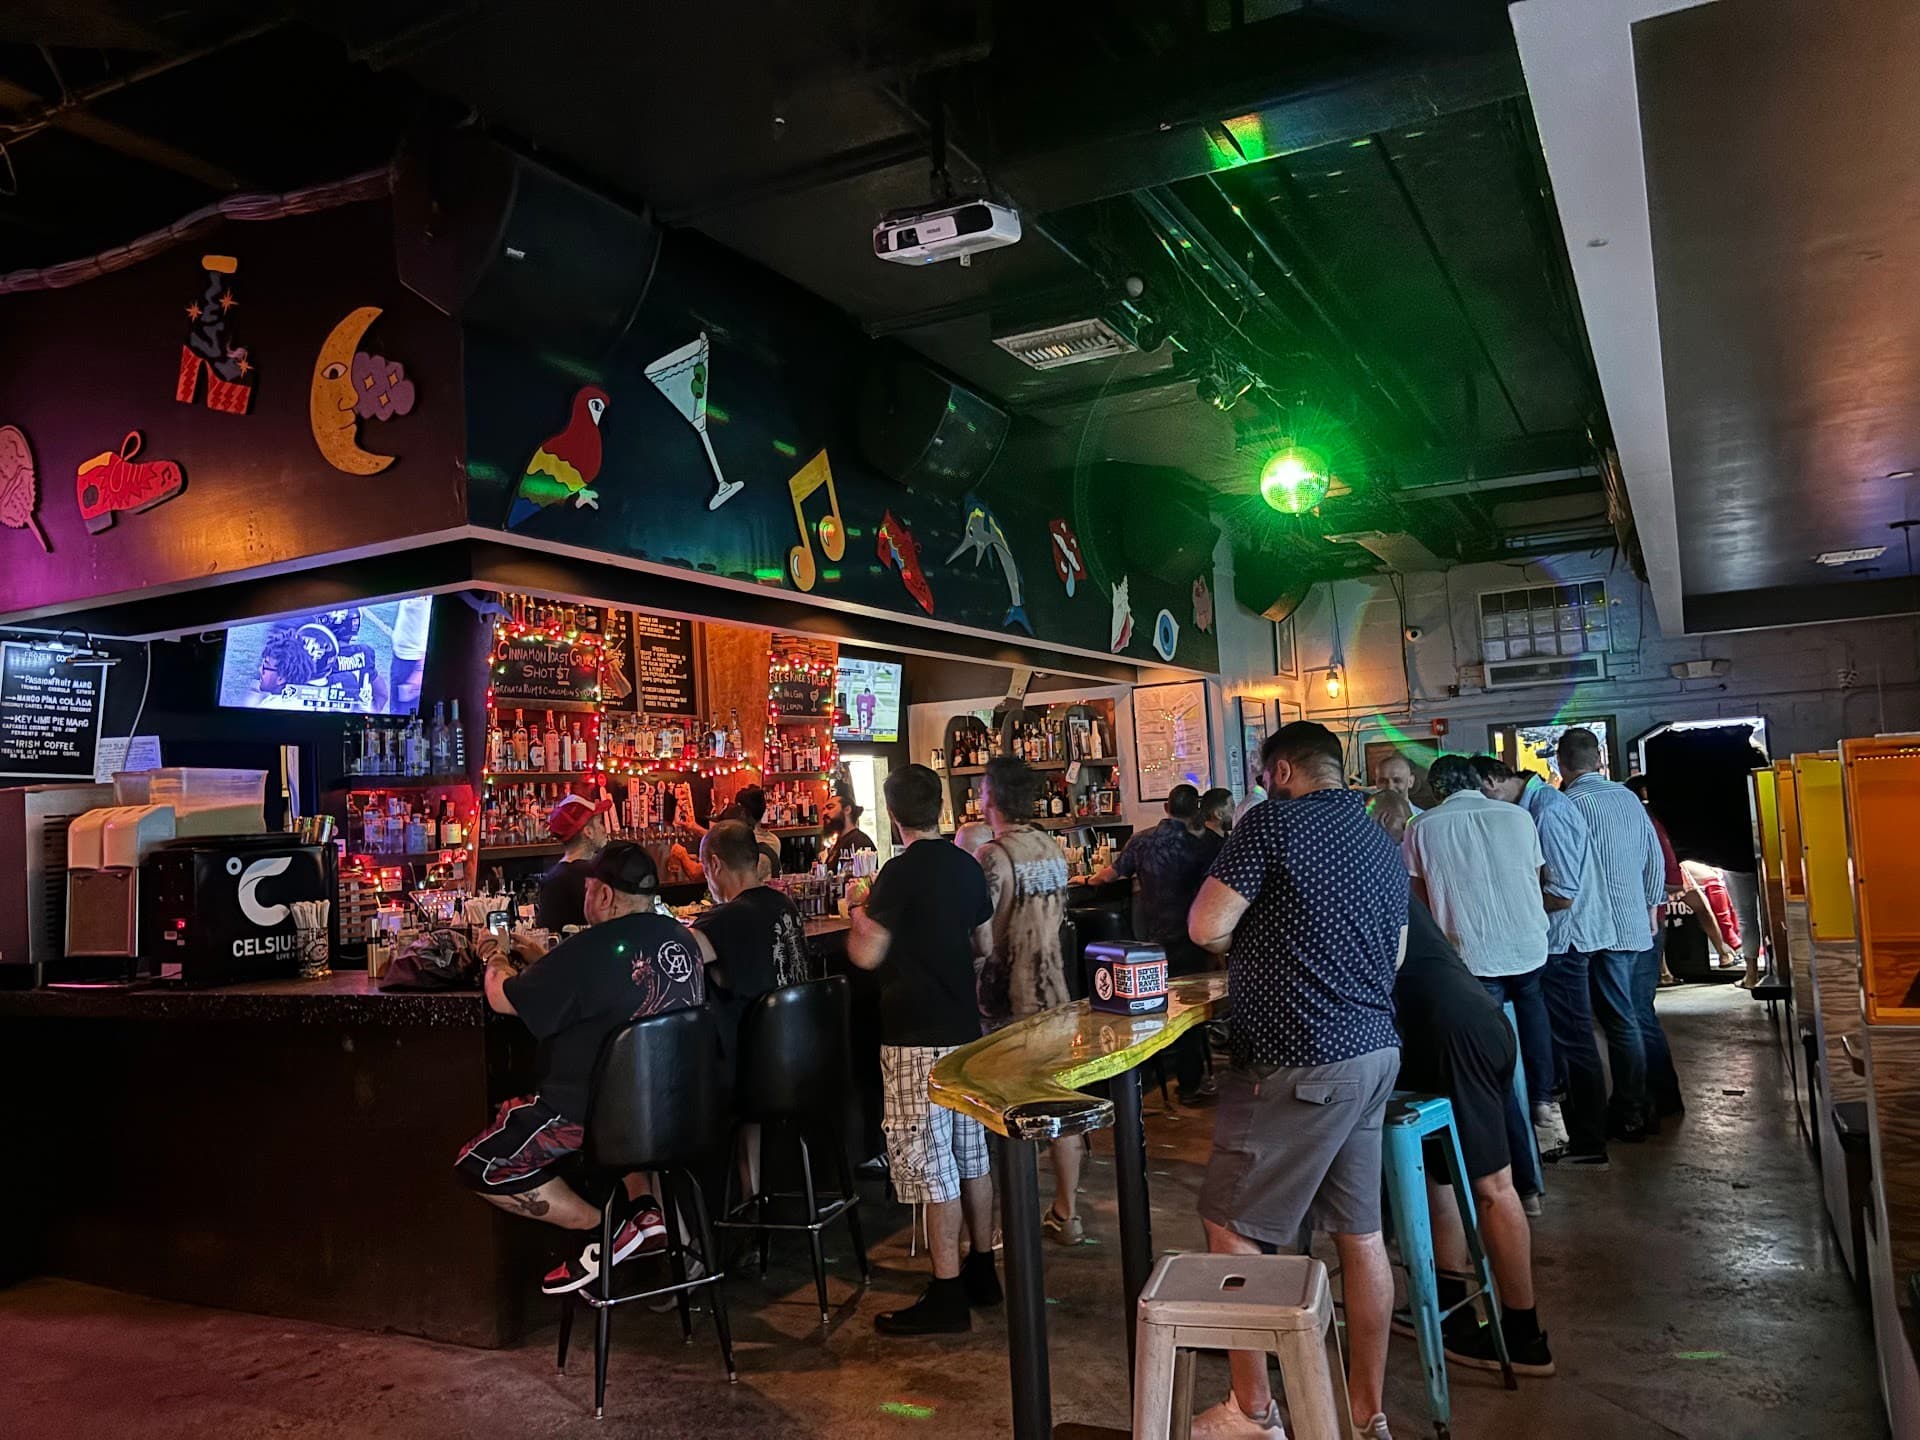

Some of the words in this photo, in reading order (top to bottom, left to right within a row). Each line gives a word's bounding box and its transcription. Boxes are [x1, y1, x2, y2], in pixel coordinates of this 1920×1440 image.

[497, 641, 546, 664] CINNAMON
[544, 643, 569, 665] TOAST
[522, 664, 555, 679] SHOT
[556, 664, 570, 680] $7
[58, 698, 93, 707] COLADA
[14, 715, 32, 724] KEY
[52, 716, 65, 726] PIE
[66, 717, 89, 728] MARG
[15, 739, 40, 749] IRISH
[44, 741, 75, 751] COFFEE
